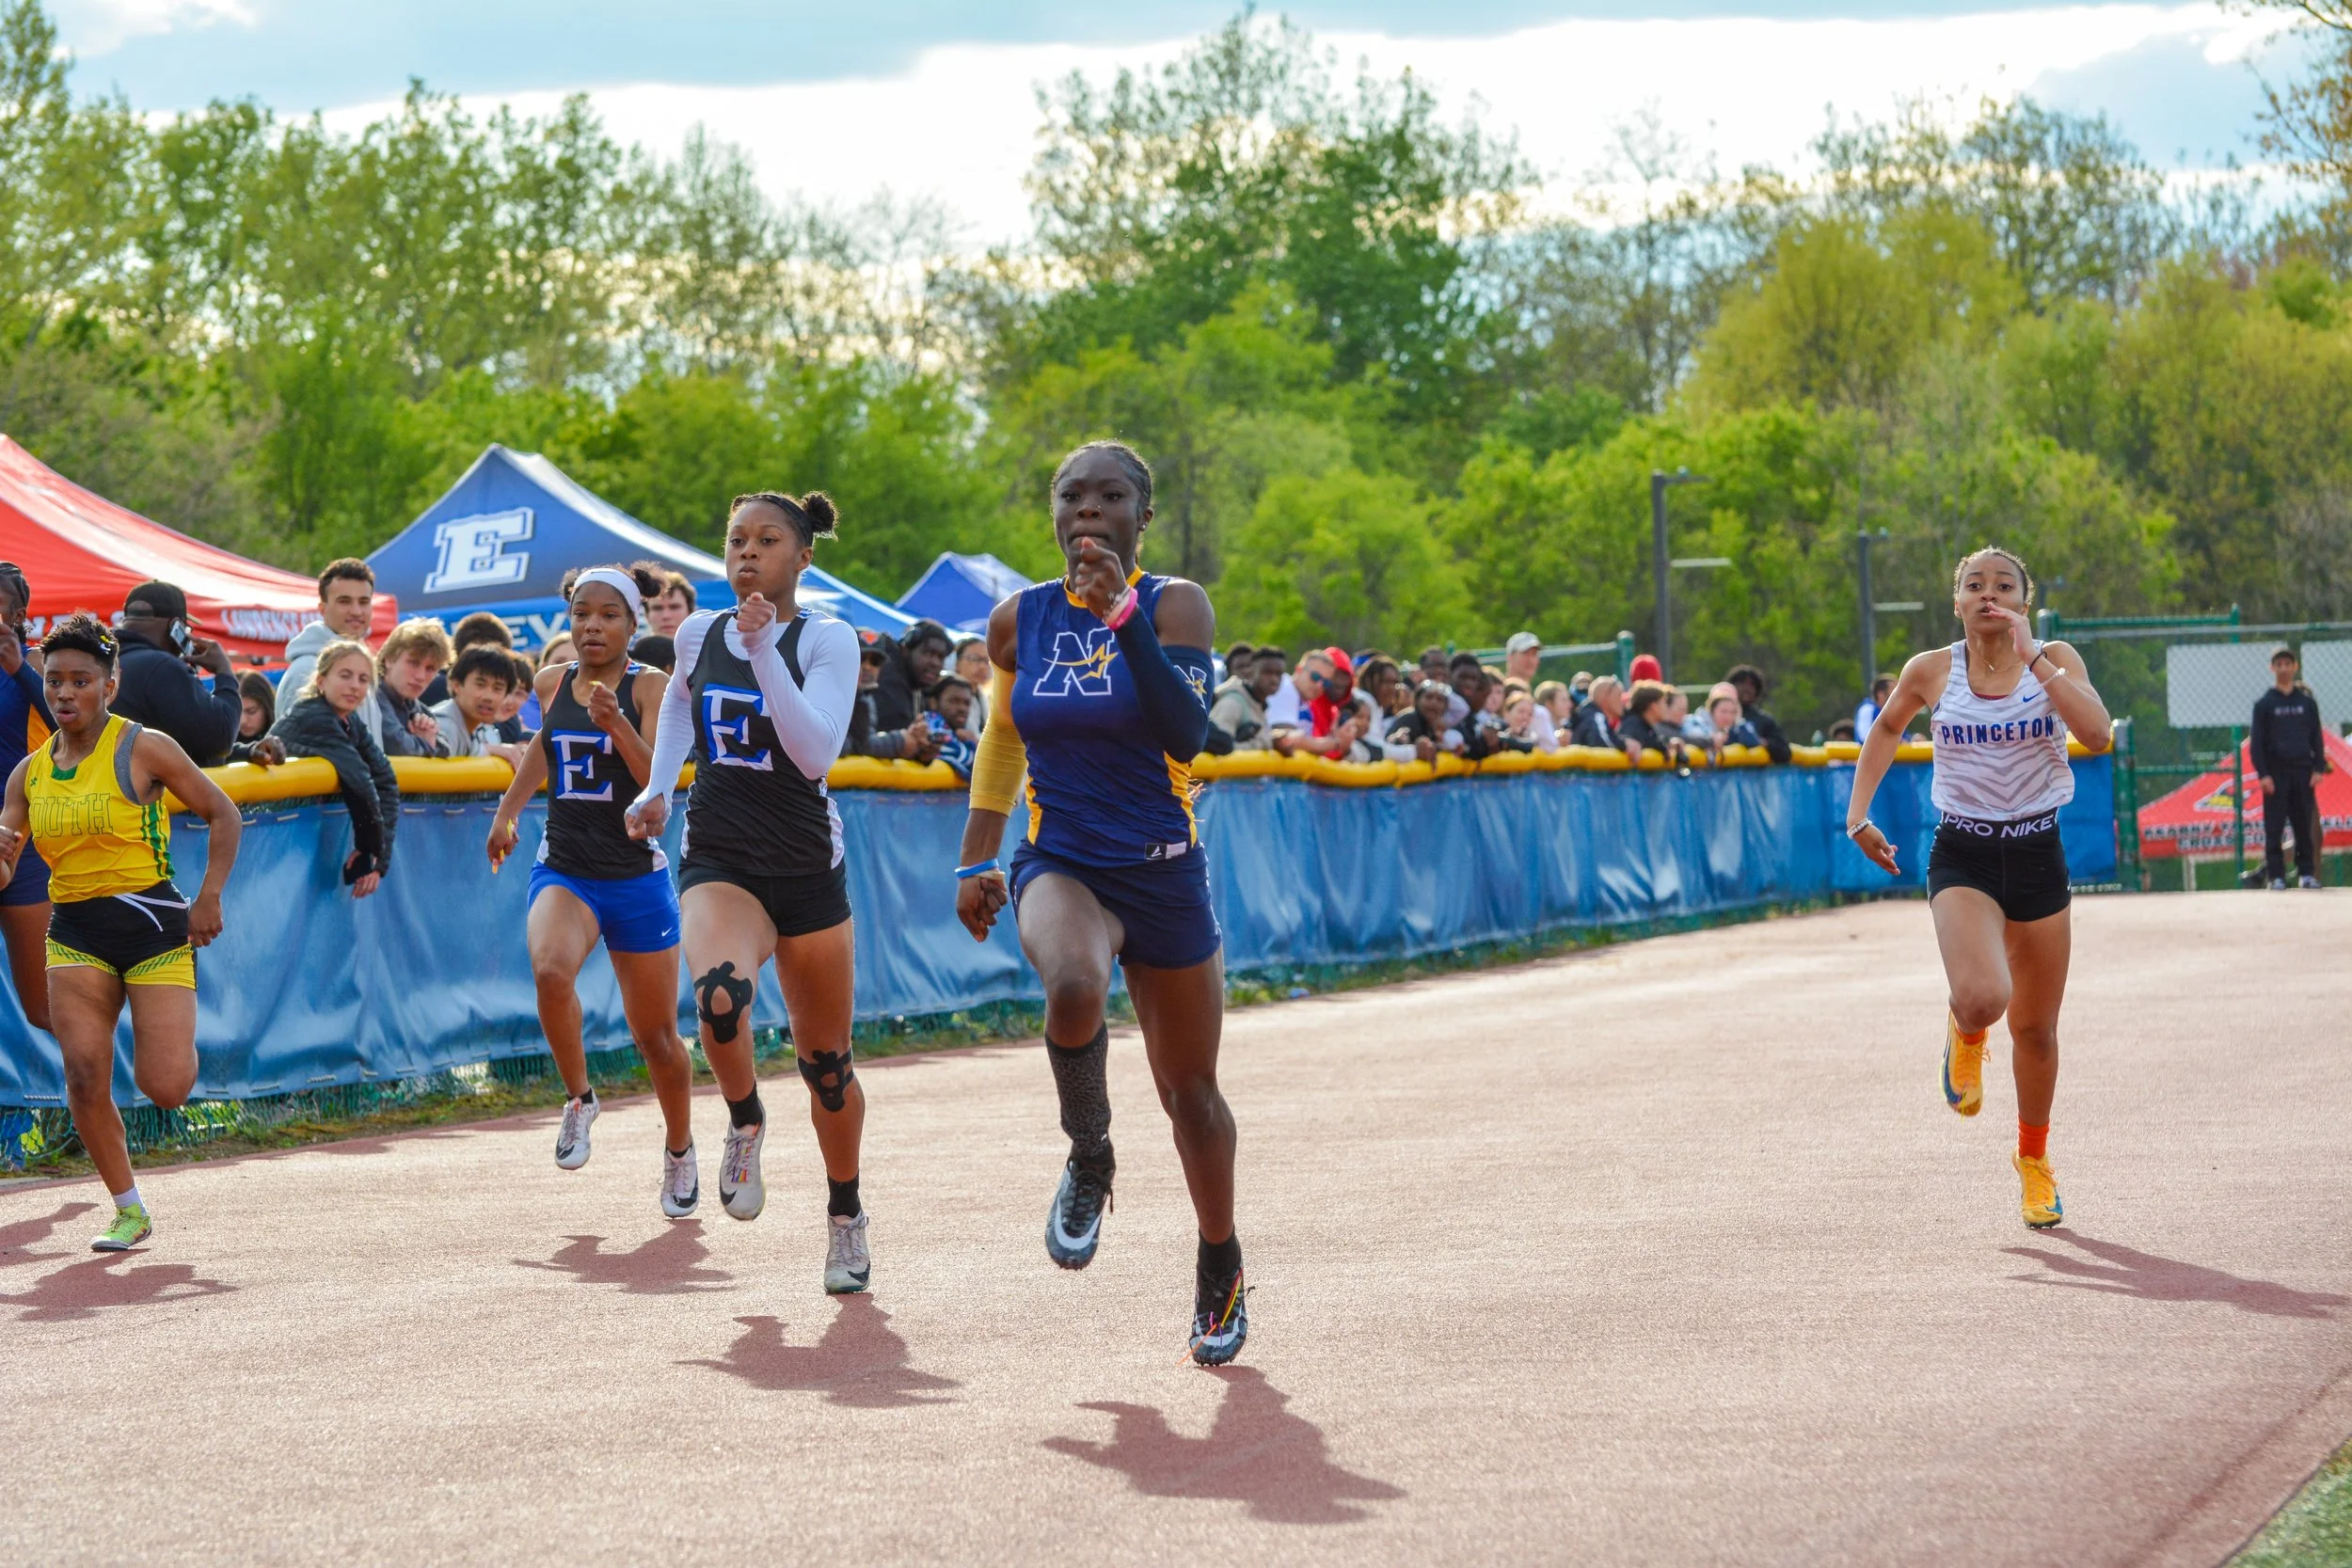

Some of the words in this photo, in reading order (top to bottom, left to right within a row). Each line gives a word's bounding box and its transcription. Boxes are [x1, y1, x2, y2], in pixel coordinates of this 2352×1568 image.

[423, 507, 534, 594] E
[702, 683, 773, 771] E
[1941, 716, 2054, 745] PRINCETON
[551, 729, 612, 800] E
[30, 793, 113, 838] OUTH
[1944, 814, 1994, 836] PRO
[2000, 815, 2054, 838] NIKE
